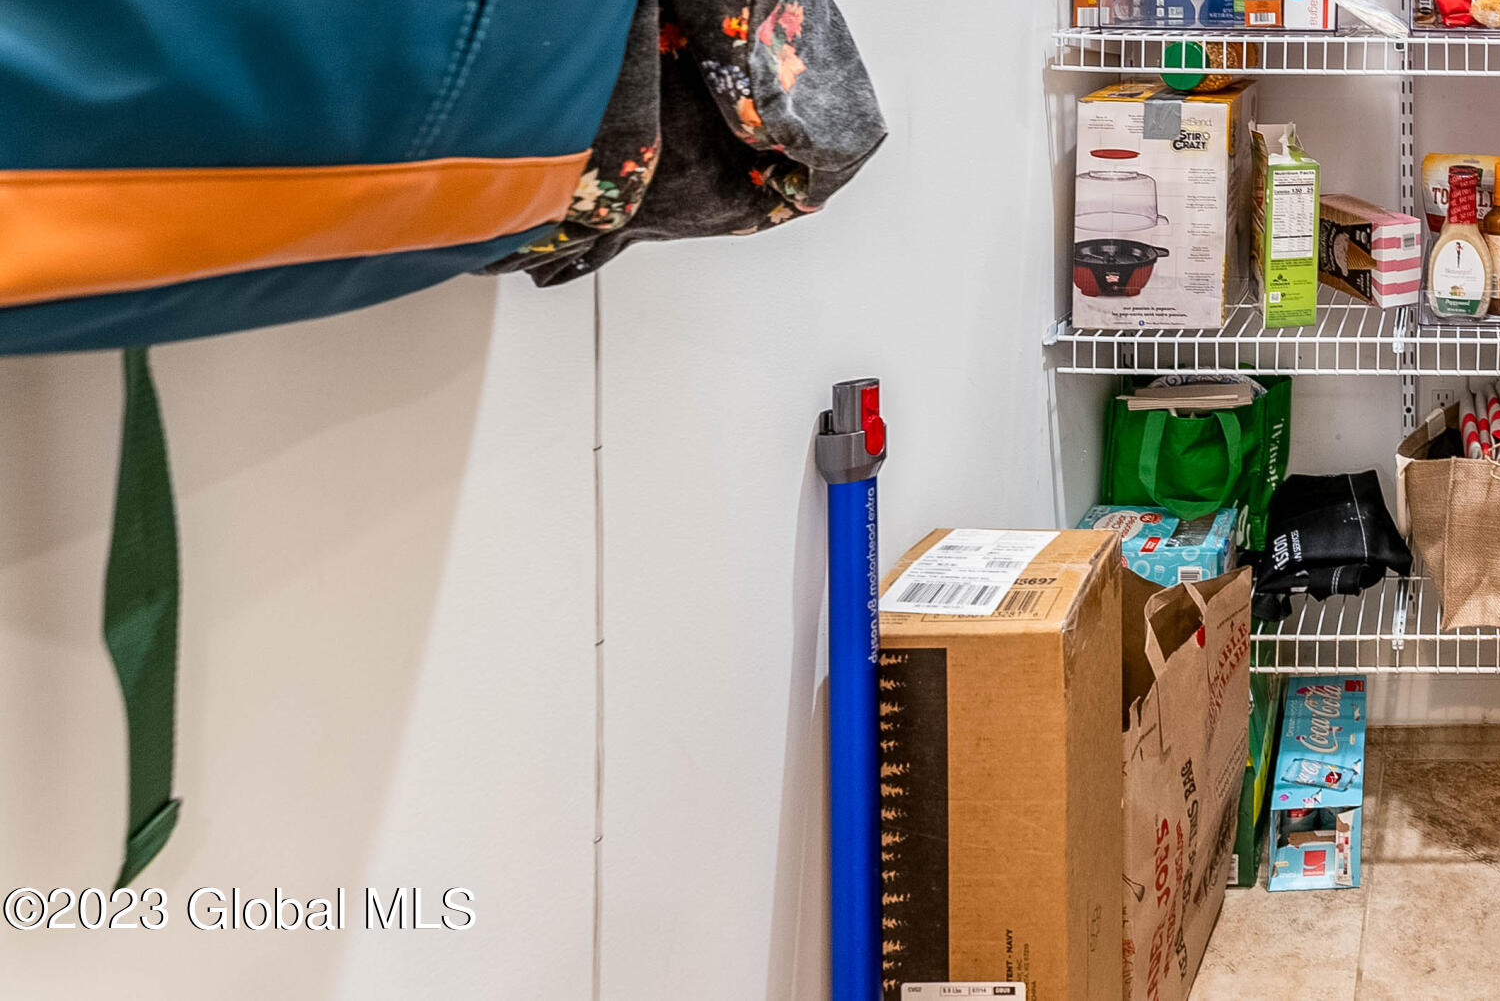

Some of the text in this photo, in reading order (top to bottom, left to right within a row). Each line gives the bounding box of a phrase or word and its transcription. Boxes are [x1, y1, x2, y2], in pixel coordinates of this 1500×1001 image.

[1172, 140, 1207, 150] CRAZY
[1179, 129, 1202, 140] STIR
[866, 487, 878, 664] dyson v8 motorhead extra
[1181, 759, 1196, 799] BAG
[1153, 818, 1171, 909] JOE'S
